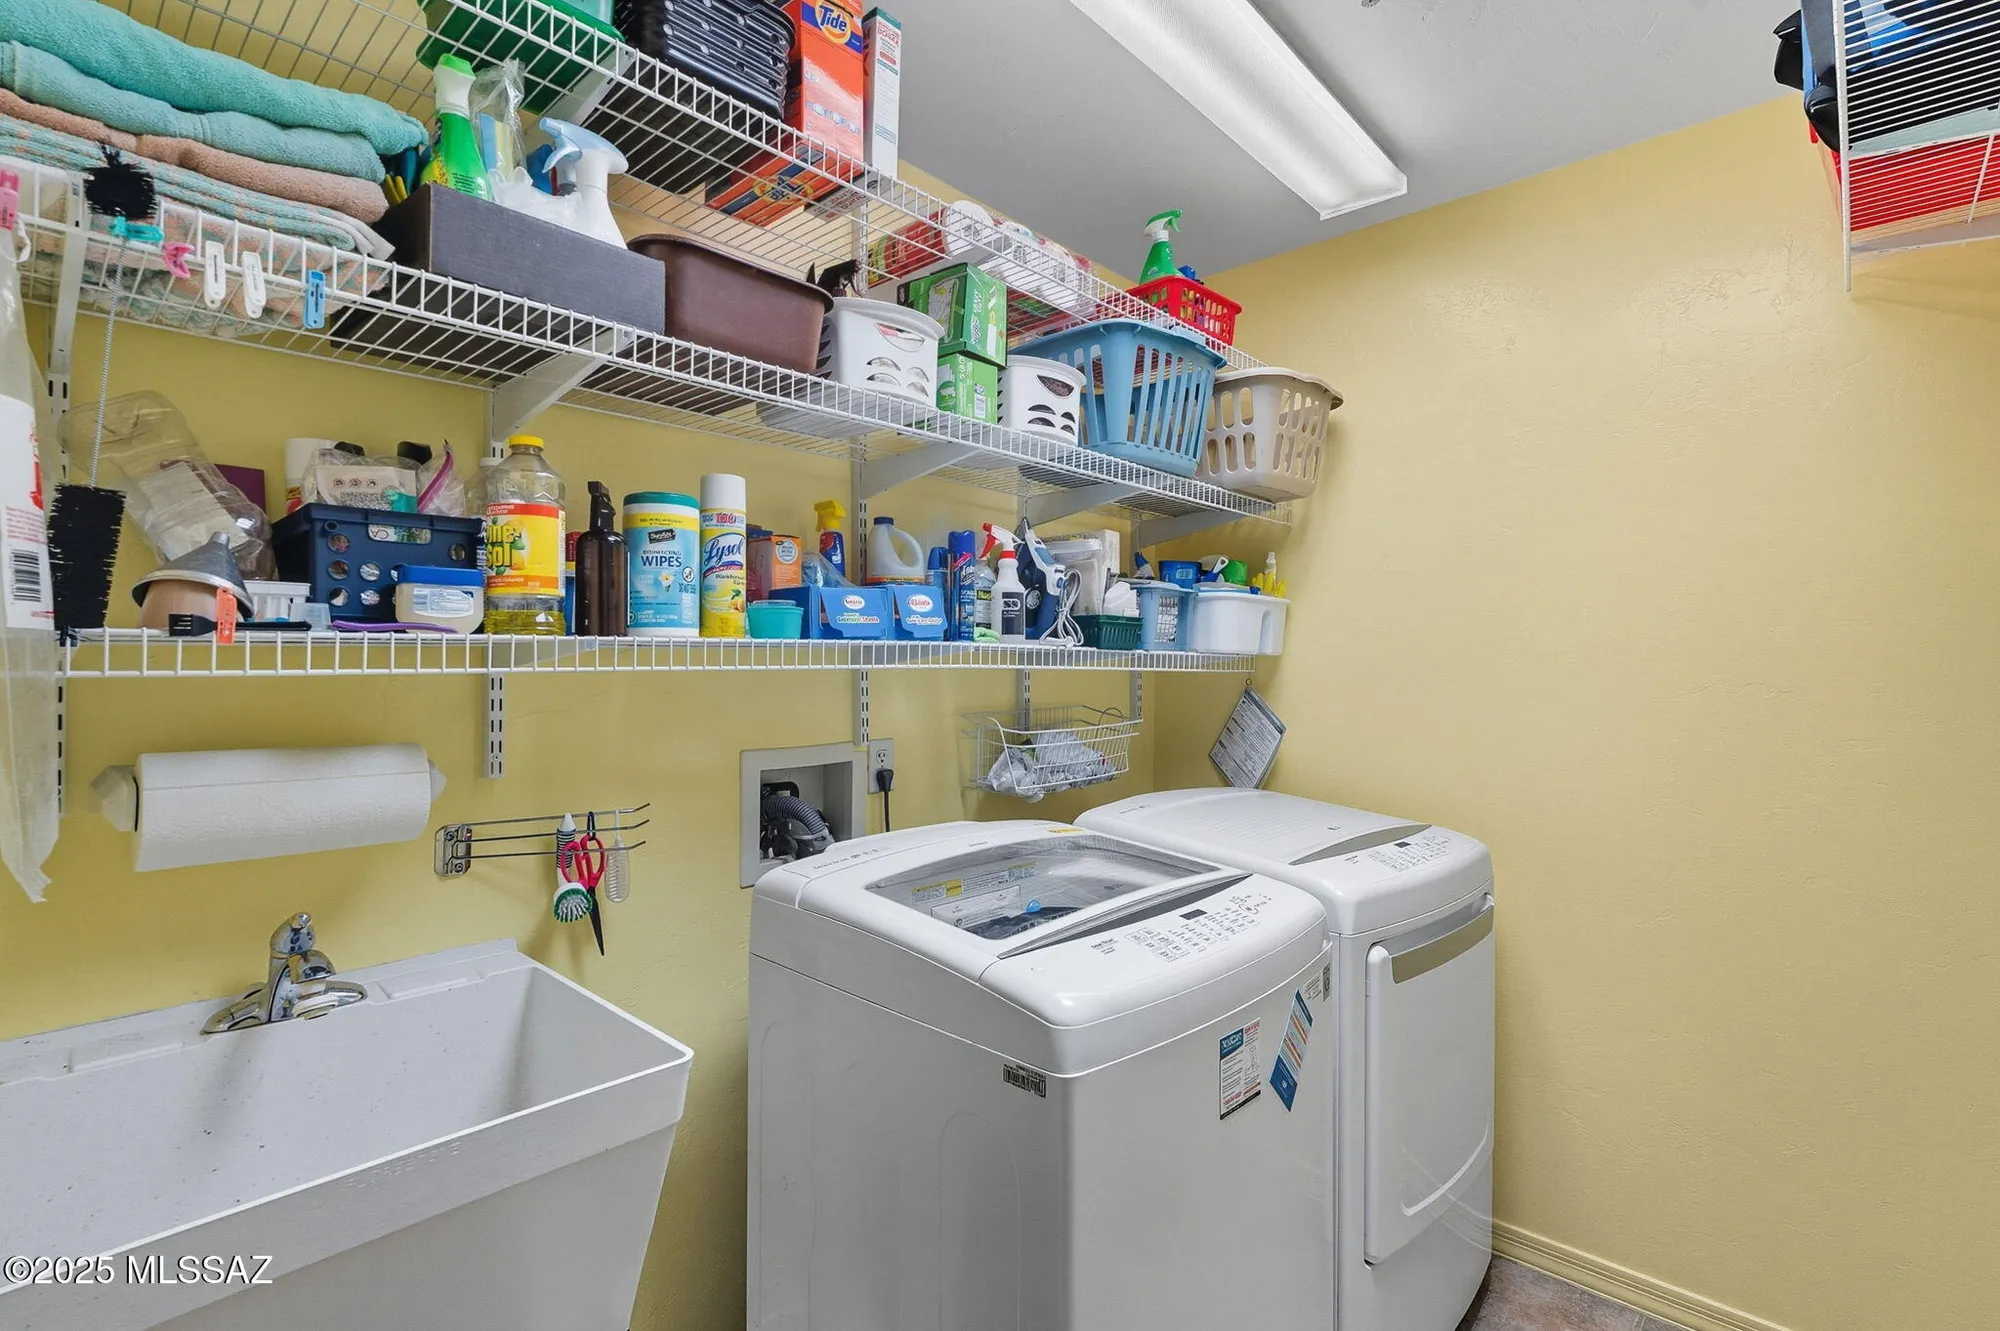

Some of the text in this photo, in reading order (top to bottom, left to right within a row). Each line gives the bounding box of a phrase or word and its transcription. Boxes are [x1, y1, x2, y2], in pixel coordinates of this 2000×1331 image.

[819, 5, 847, 32] Tide
[641, 555, 682, 568] WIPES
[703, 538, 744, 567] Lysol
